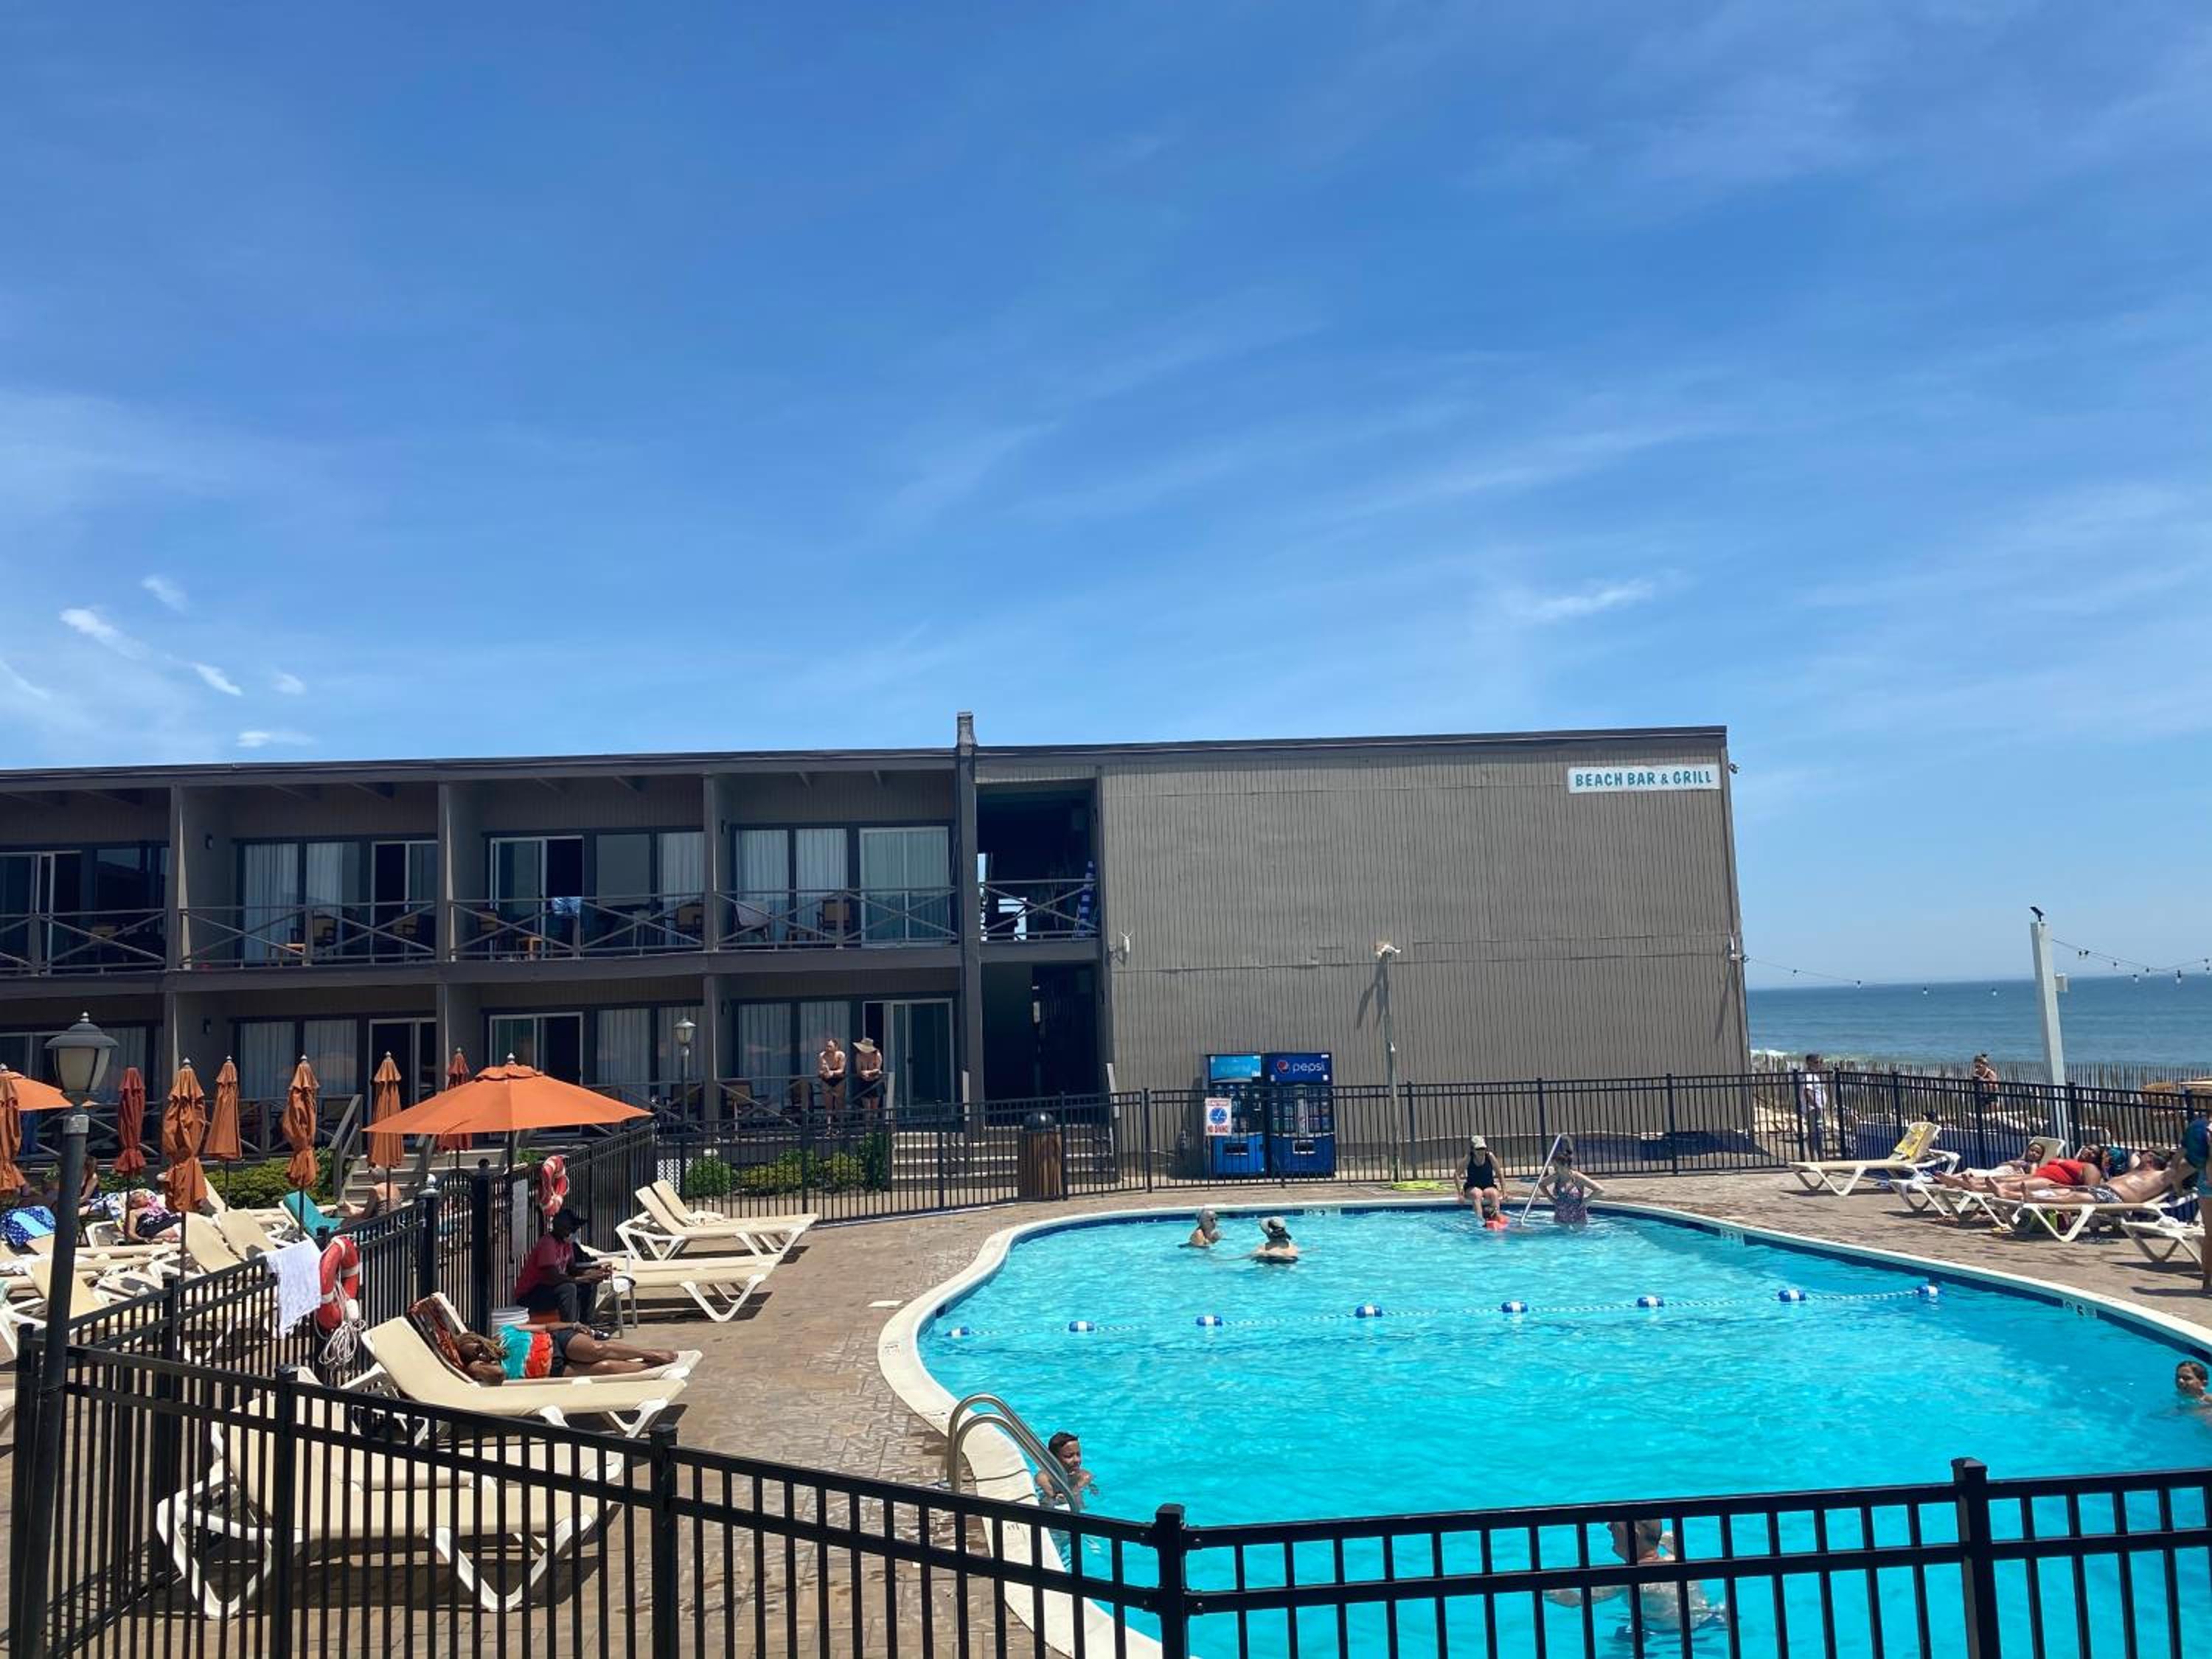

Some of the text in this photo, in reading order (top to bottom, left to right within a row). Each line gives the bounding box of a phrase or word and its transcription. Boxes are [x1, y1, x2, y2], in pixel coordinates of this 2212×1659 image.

[1575, 770, 1712, 787] BEACH BAR & GRILL
[1293, 1062, 1325, 1074] pepsi
